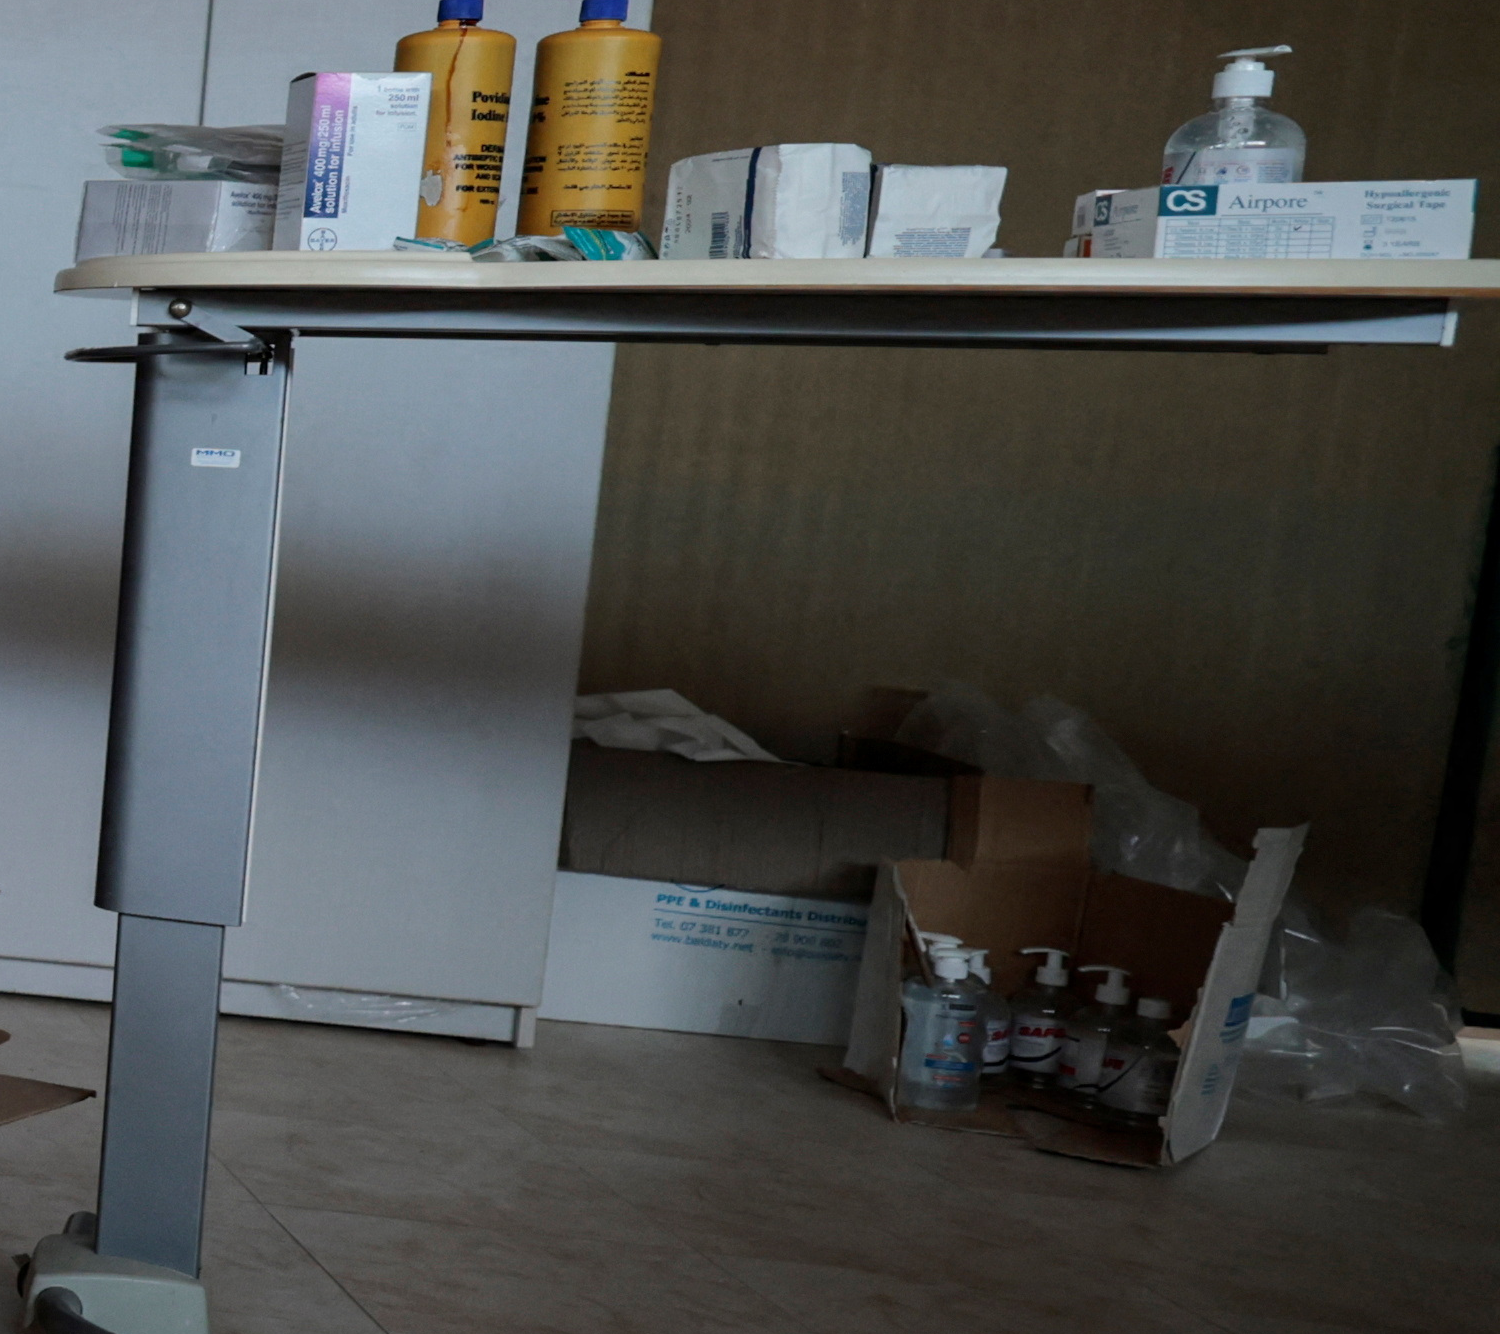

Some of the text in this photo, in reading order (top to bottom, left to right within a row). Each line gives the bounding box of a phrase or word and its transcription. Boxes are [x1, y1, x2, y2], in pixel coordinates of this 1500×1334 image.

[388, 93, 420, 102] 250 ml
[313, 157, 327, 177] 400
[320, 105, 331, 118] ml
[325, 109, 345, 214] solution for infusion
[455, 185, 475, 193] FOR
[1364, 189, 1451, 199] Hypoallergenic
[1166, 189, 1308, 213] CS Airpore
[1366, 201, 1446, 211] Surgical Tape
[657, 893, 686, 907] PPE
[689, 898, 700, 908] &
[705, 899, 803, 919] Disinfectants
